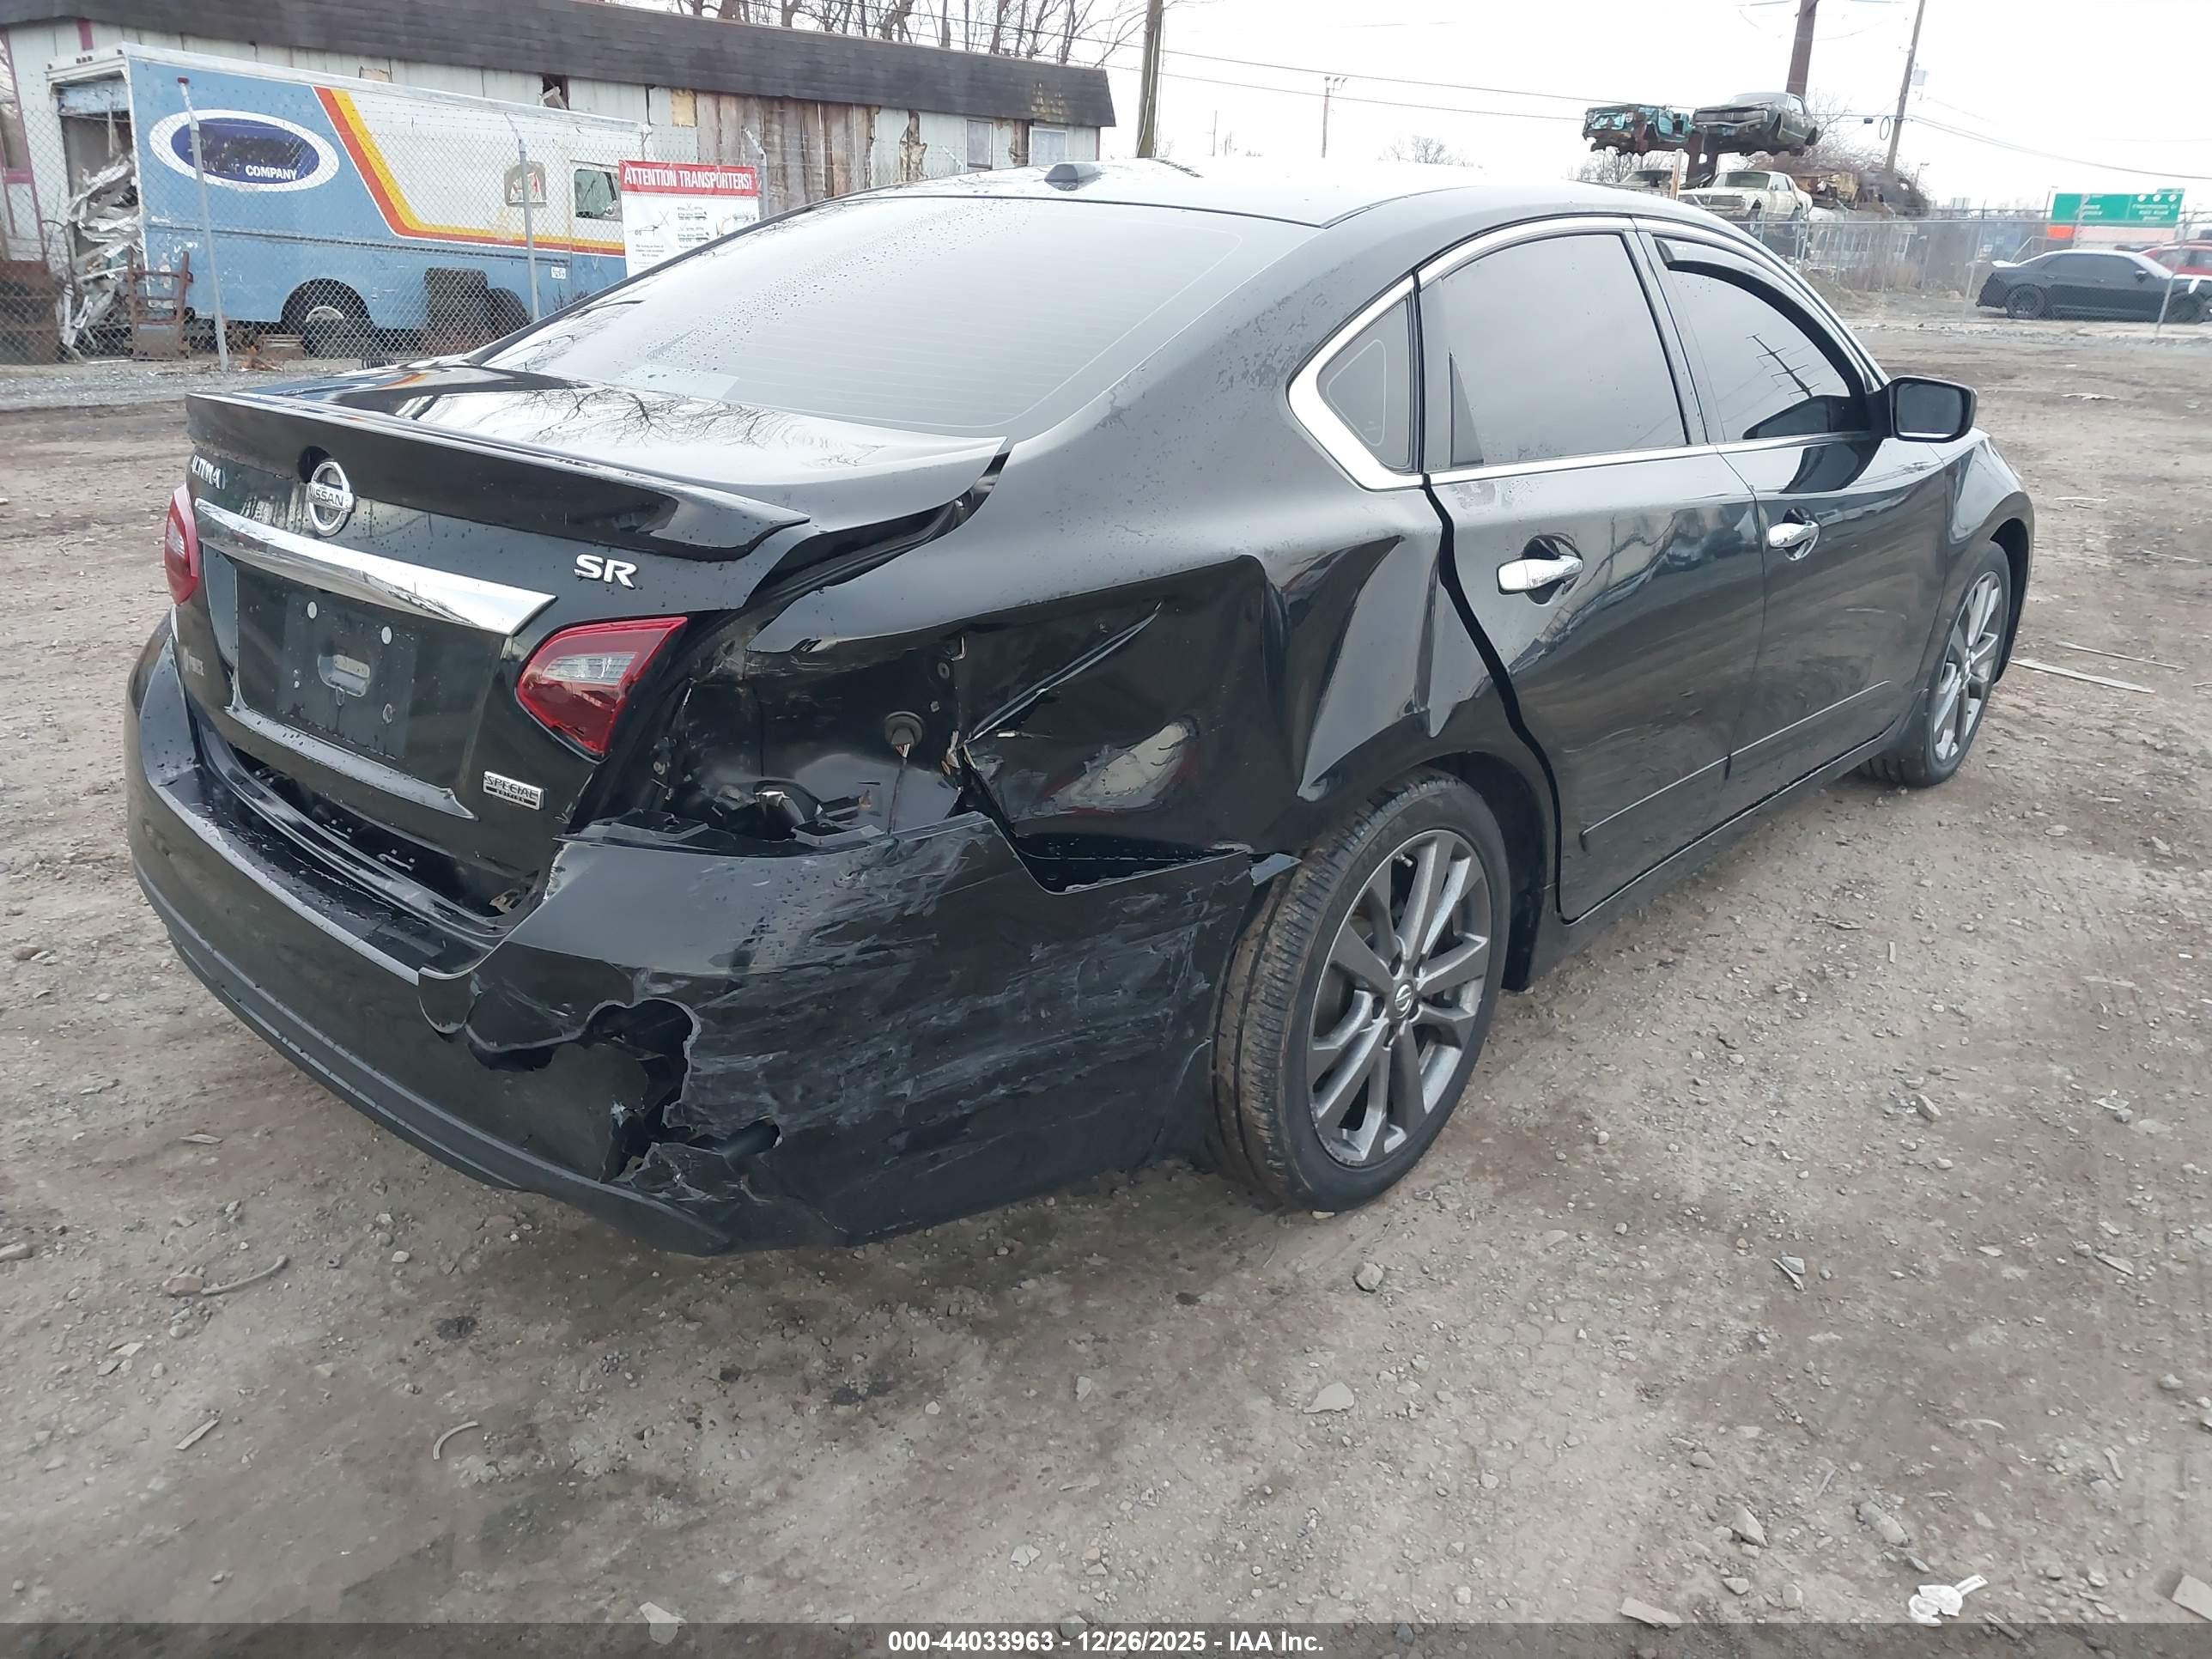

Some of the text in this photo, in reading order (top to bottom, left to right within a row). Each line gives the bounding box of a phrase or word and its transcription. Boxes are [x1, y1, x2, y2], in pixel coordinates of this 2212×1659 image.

[245, 165, 298, 180] COMPANY
[623, 167, 752, 190] ATTENTION TRANSPORTERS!
[308, 484, 344, 507] NISSAN
[574, 554, 637, 588] SR
[483, 775, 539, 800] SPECIAL
